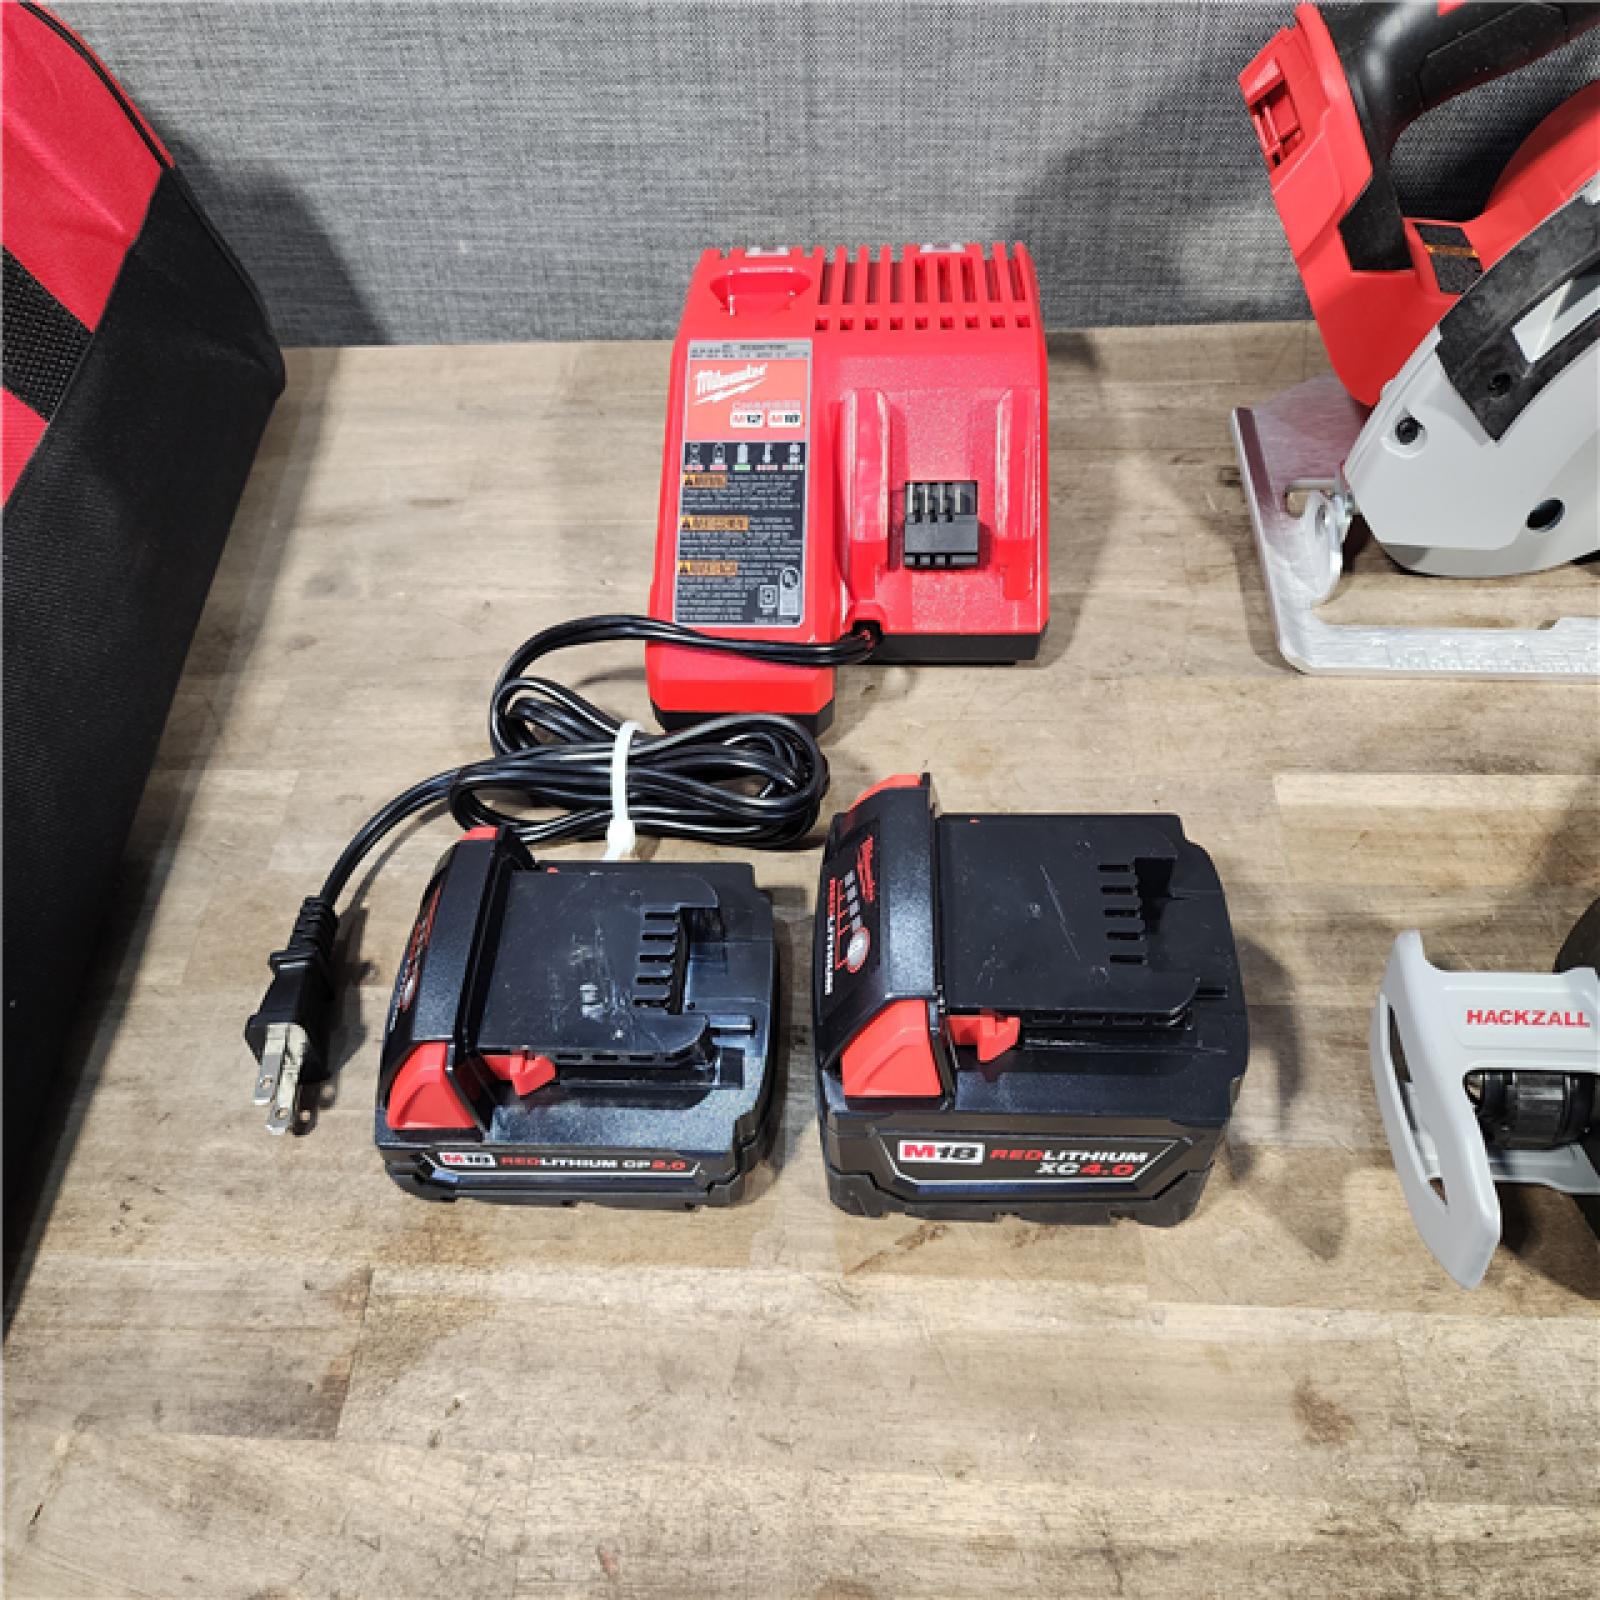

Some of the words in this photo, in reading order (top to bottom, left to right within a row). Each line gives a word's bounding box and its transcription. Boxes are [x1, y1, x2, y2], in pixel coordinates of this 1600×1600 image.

[1466, 1008, 1591, 1028] HACKZALL
[442, 1153, 494, 1166] M18
[501, 1156, 618, 1168] REDLITHIUM
[902, 1143, 980, 1159] M18
[989, 1149, 1149, 1162] REDLITHIUM
